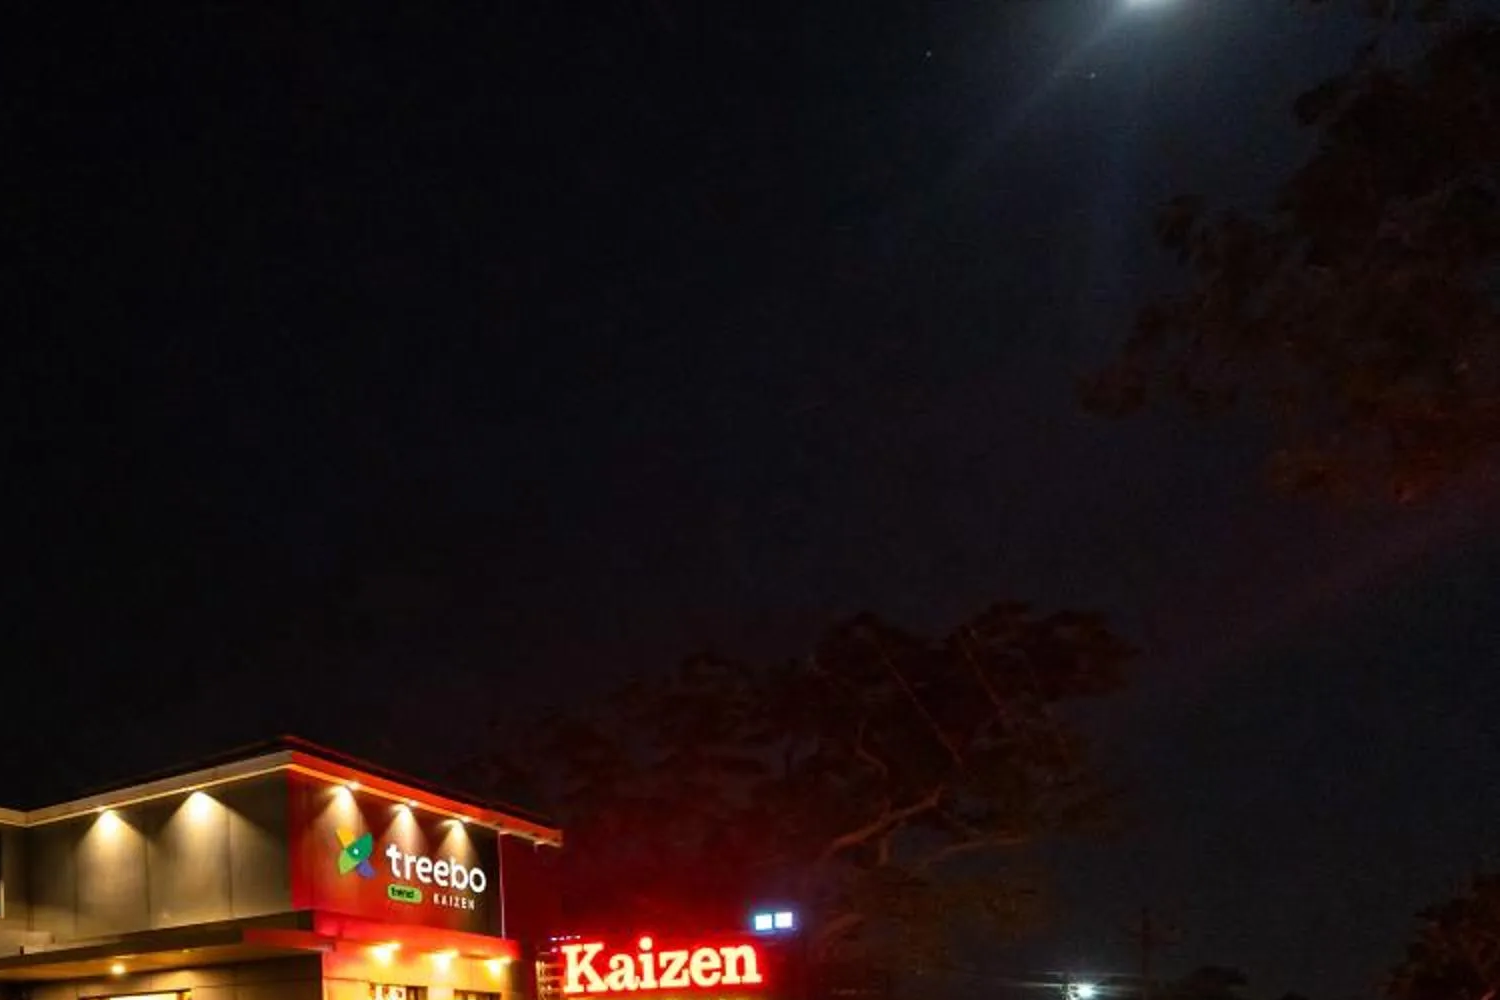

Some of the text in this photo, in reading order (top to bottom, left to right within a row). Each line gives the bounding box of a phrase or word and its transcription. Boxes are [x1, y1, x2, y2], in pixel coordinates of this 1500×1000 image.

[386, 844, 487, 893] treebo
[432, 893, 475, 910] KAIZEN
[561, 937, 762, 993] Kaizen
